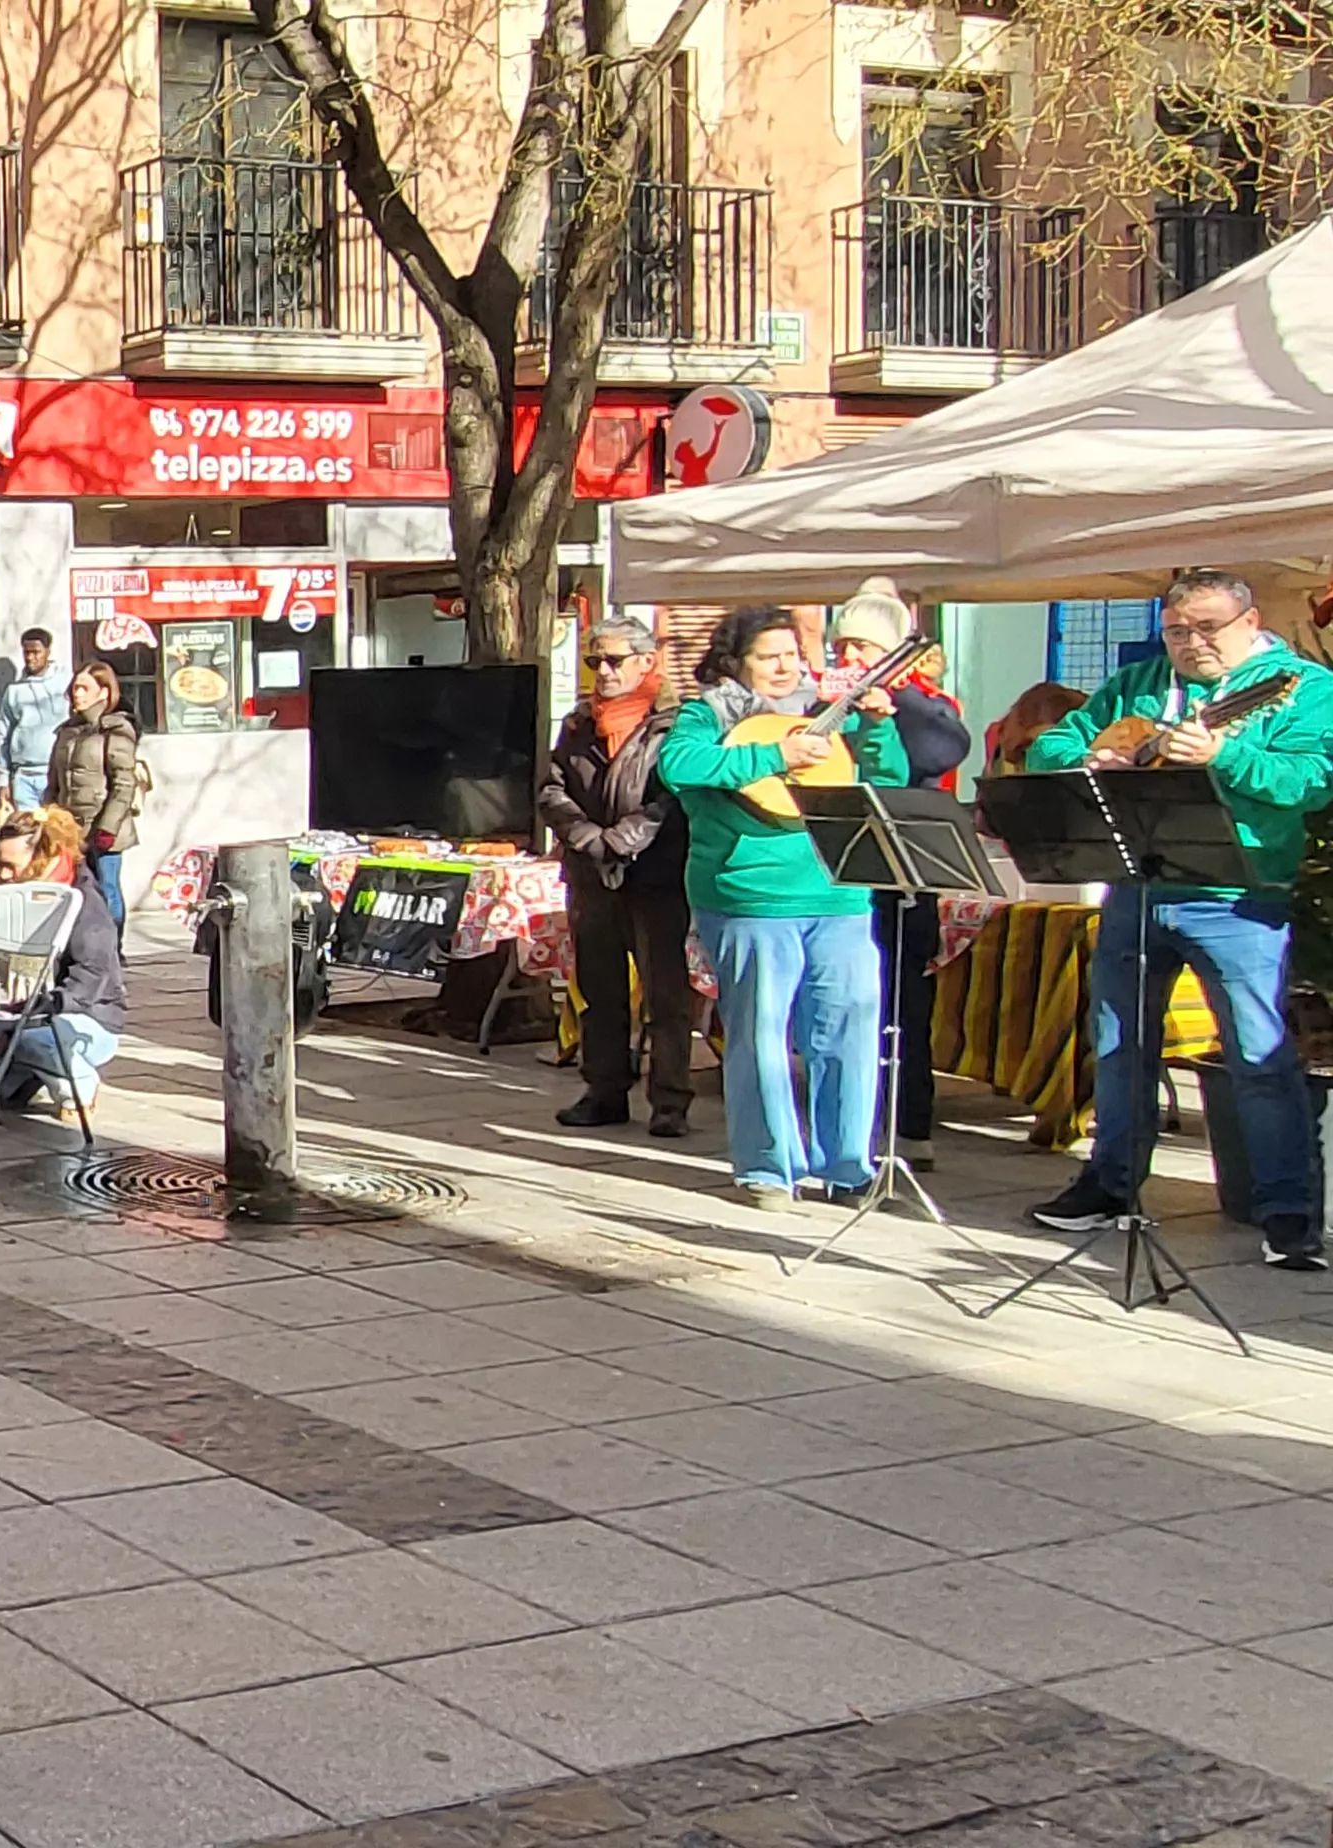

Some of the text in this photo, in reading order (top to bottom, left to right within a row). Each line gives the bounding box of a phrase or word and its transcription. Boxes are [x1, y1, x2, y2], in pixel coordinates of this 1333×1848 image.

[188, 409, 353, 440] 974 226 399
[150, 444, 353, 492] telepizza.es
[371, 892, 447, 925] MILAR
